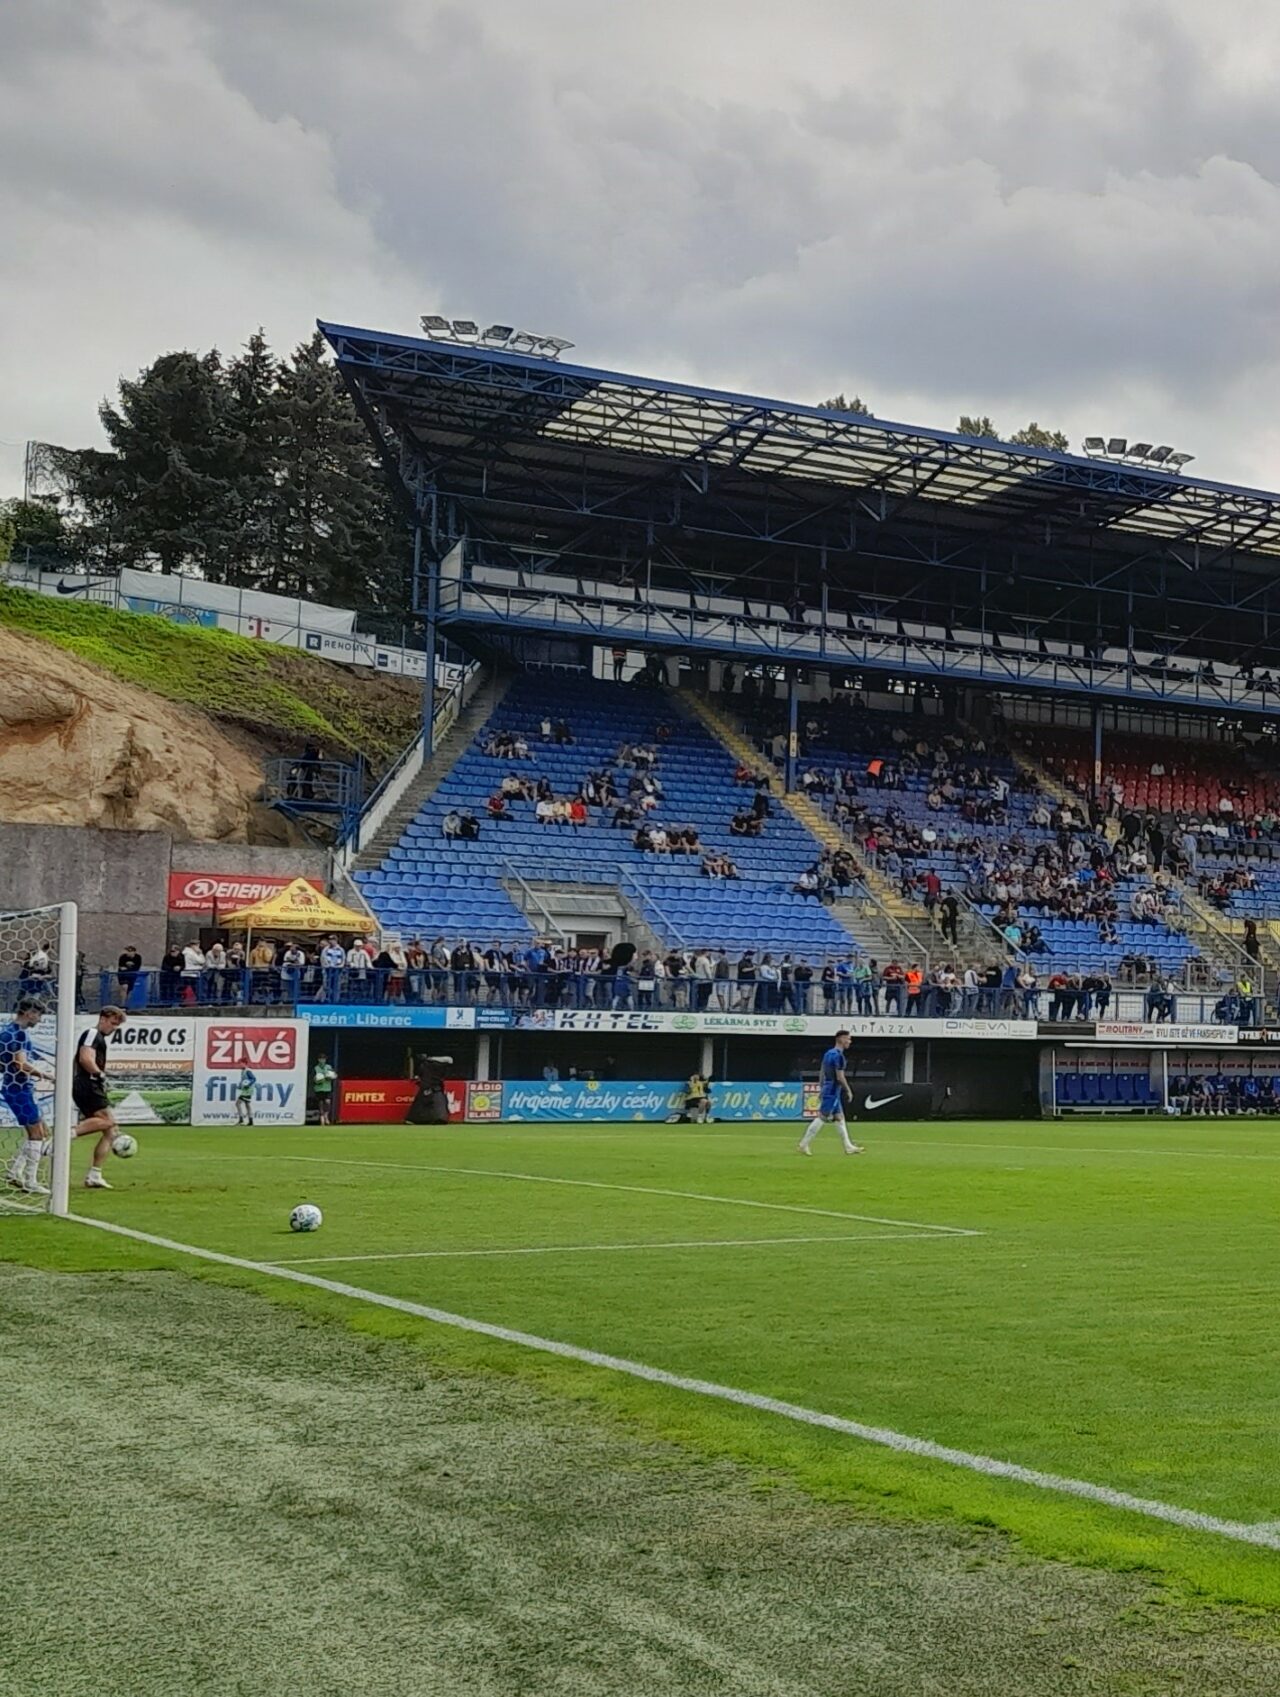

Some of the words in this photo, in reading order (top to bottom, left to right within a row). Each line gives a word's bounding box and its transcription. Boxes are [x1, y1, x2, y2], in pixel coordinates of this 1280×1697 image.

[324, 639, 369, 652] RENOMIA
[302, 1012, 347, 1025] Bazén
[356, 1013, 412, 1026] Liberec
[110, 1027, 163, 1046] AGRO
[167, 1028, 187, 1046] CS
[211, 1030, 290, 1064] živé
[141, 1062, 183, 1070] TRÁVNÍKY
[470, 1082, 502, 1091] RÁDIO
[345, 1093, 386, 1103] FINTEX
[508, 1091, 572, 1114] Hrajeme
[575, 1091, 621, 1114] hezky
[622, 1091, 664, 1114] česky
[773, 1093, 798, 1110] FM
